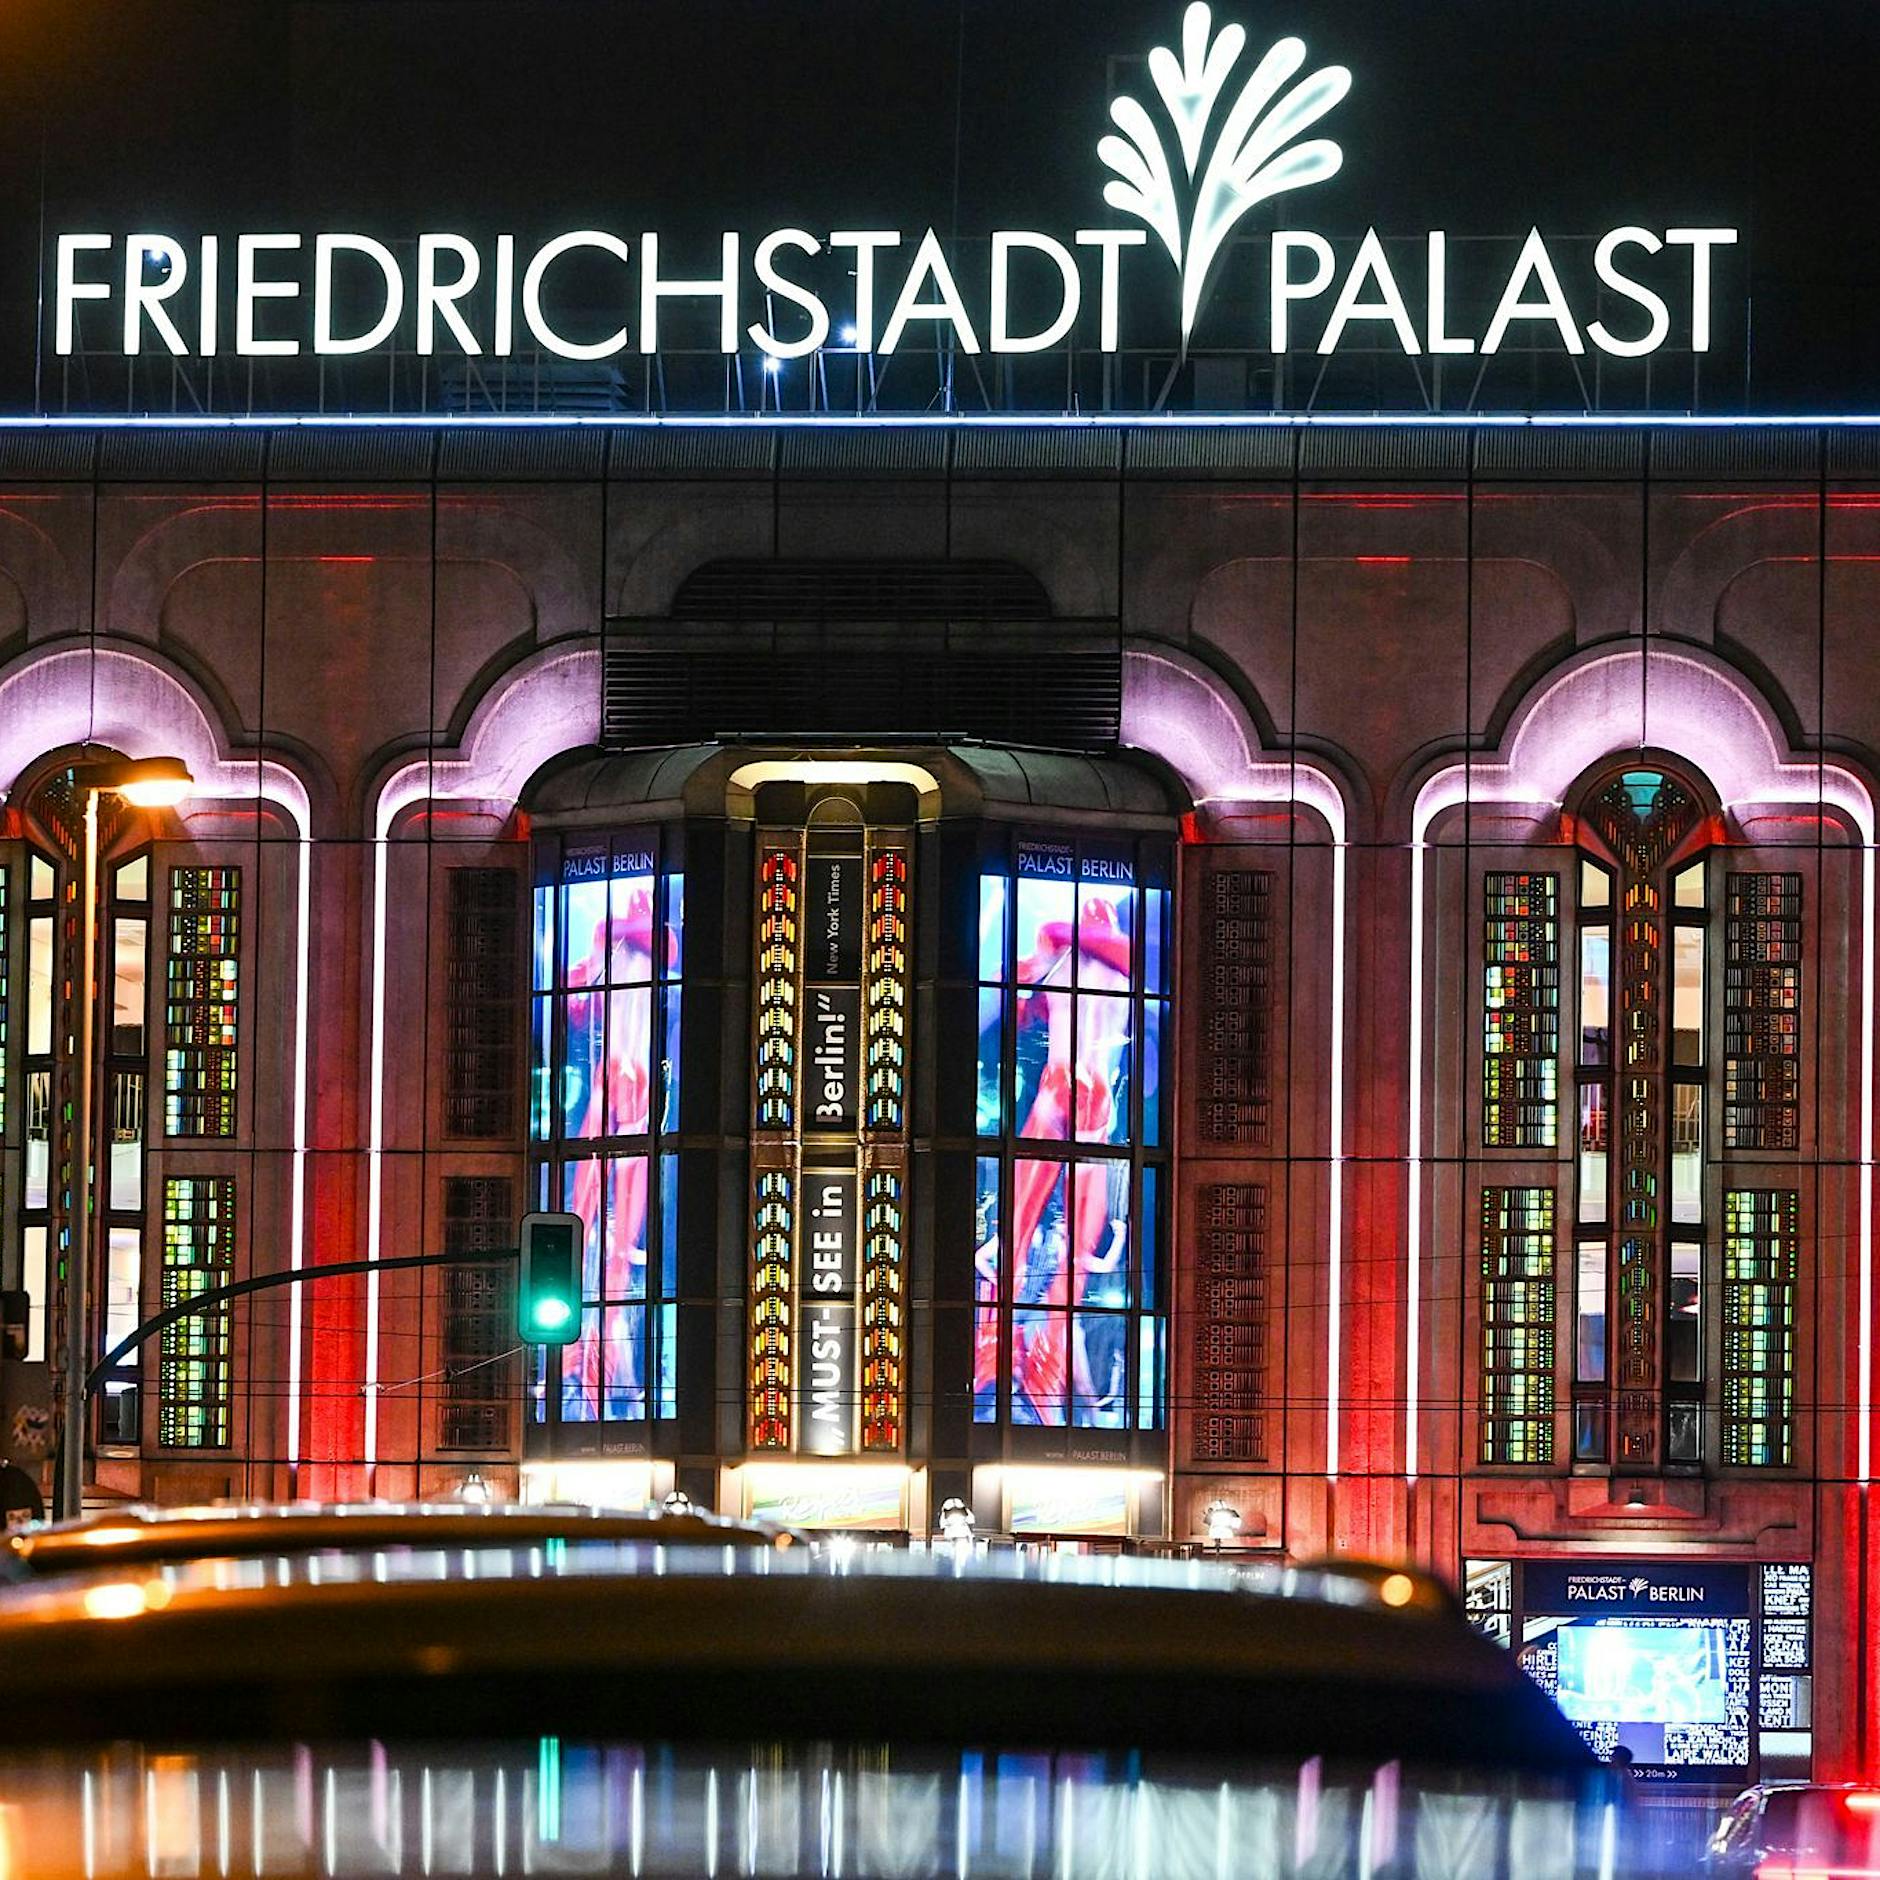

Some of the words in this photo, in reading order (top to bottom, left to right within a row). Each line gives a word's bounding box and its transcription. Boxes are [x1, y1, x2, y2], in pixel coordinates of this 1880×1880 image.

[55, 227, 1148, 361] FRIEDRICHSTADT
[1268, 225, 1739, 358] PALAST
[563, 856, 607, 877] PALAST
[613, 851, 654, 872] BERLIN
[1018, 853, 1074, 875] PALAST
[1081, 858, 1133, 880] BERLIN
[826, 863, 842, 904] Times
[826, 907, 841, 938] York
[826, 943, 840, 975] New
[811, 1185, 843, 1218] in
[812, 1230, 843, 1293] SEE
[1567, 1584, 1627, 1601] PALAST
[1649, 1586, 1704, 1602] BERLIN
